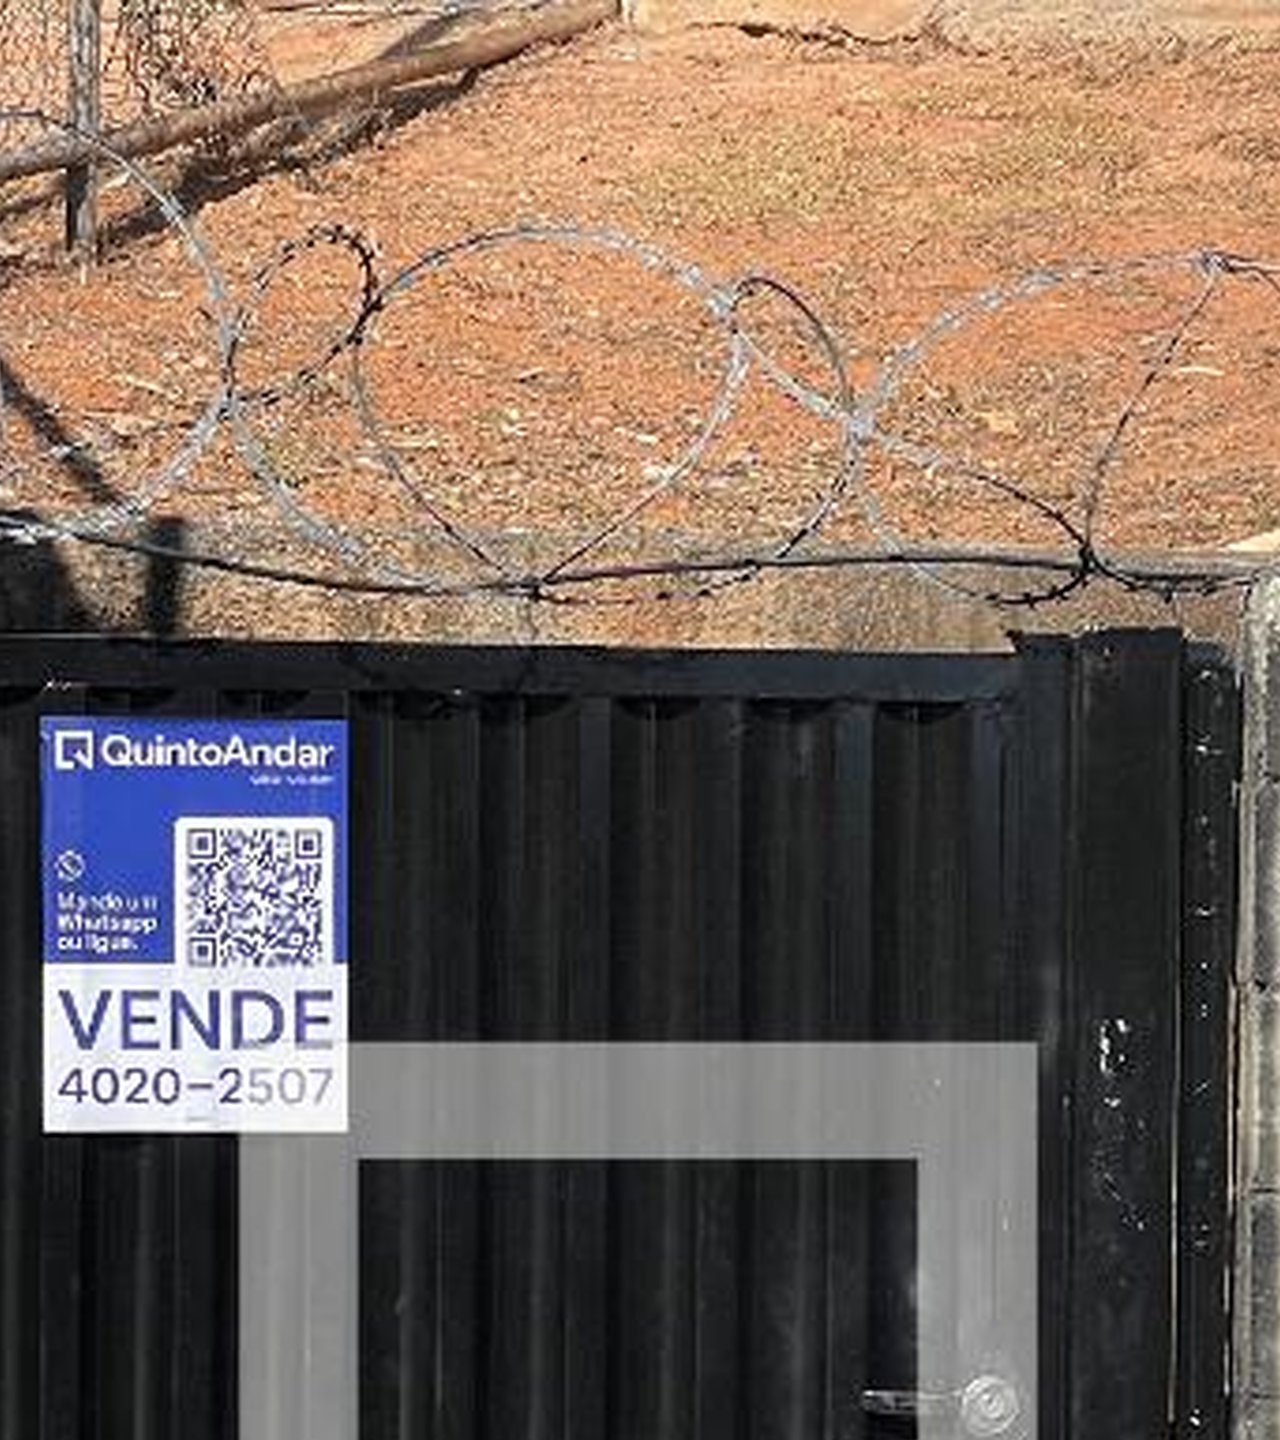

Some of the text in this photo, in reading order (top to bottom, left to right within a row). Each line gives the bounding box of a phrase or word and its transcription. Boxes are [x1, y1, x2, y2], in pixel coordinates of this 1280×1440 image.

[101, 734, 334, 768] QuintoAndar
[58, 989, 333, 1050] VENDE
[58, 1067, 333, 1104] 4020-2507
